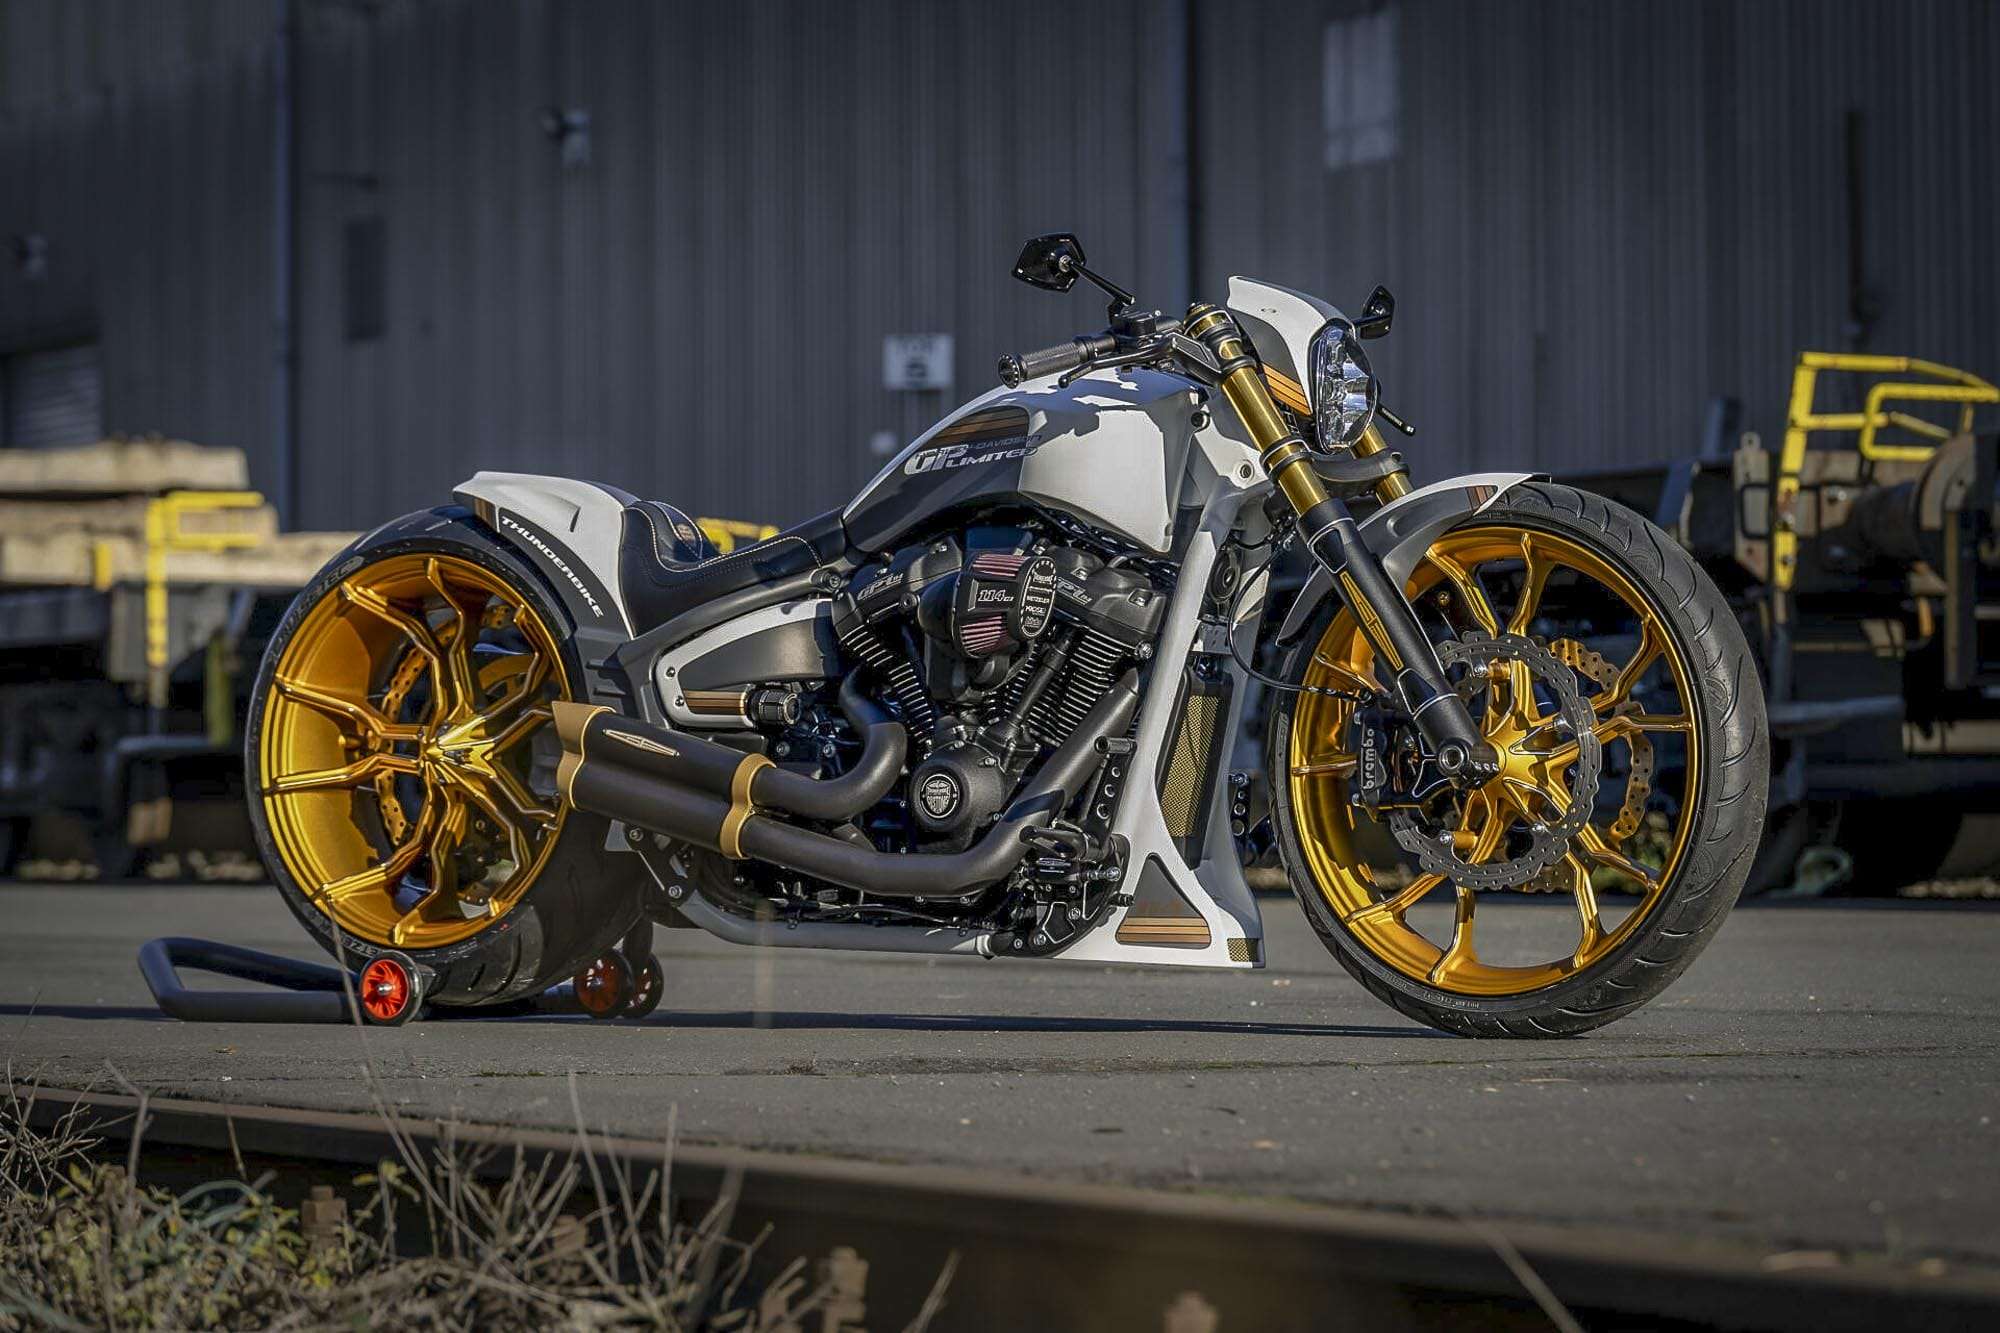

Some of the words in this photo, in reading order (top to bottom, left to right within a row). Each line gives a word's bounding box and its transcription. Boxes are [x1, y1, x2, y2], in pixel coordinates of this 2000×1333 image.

[903, 444, 970, 476] GP
[946, 446, 1038, 469] LIMITED
[501, 515, 605, 618] THUNDERBIKE
[1362, 728, 1375, 790] brembo
